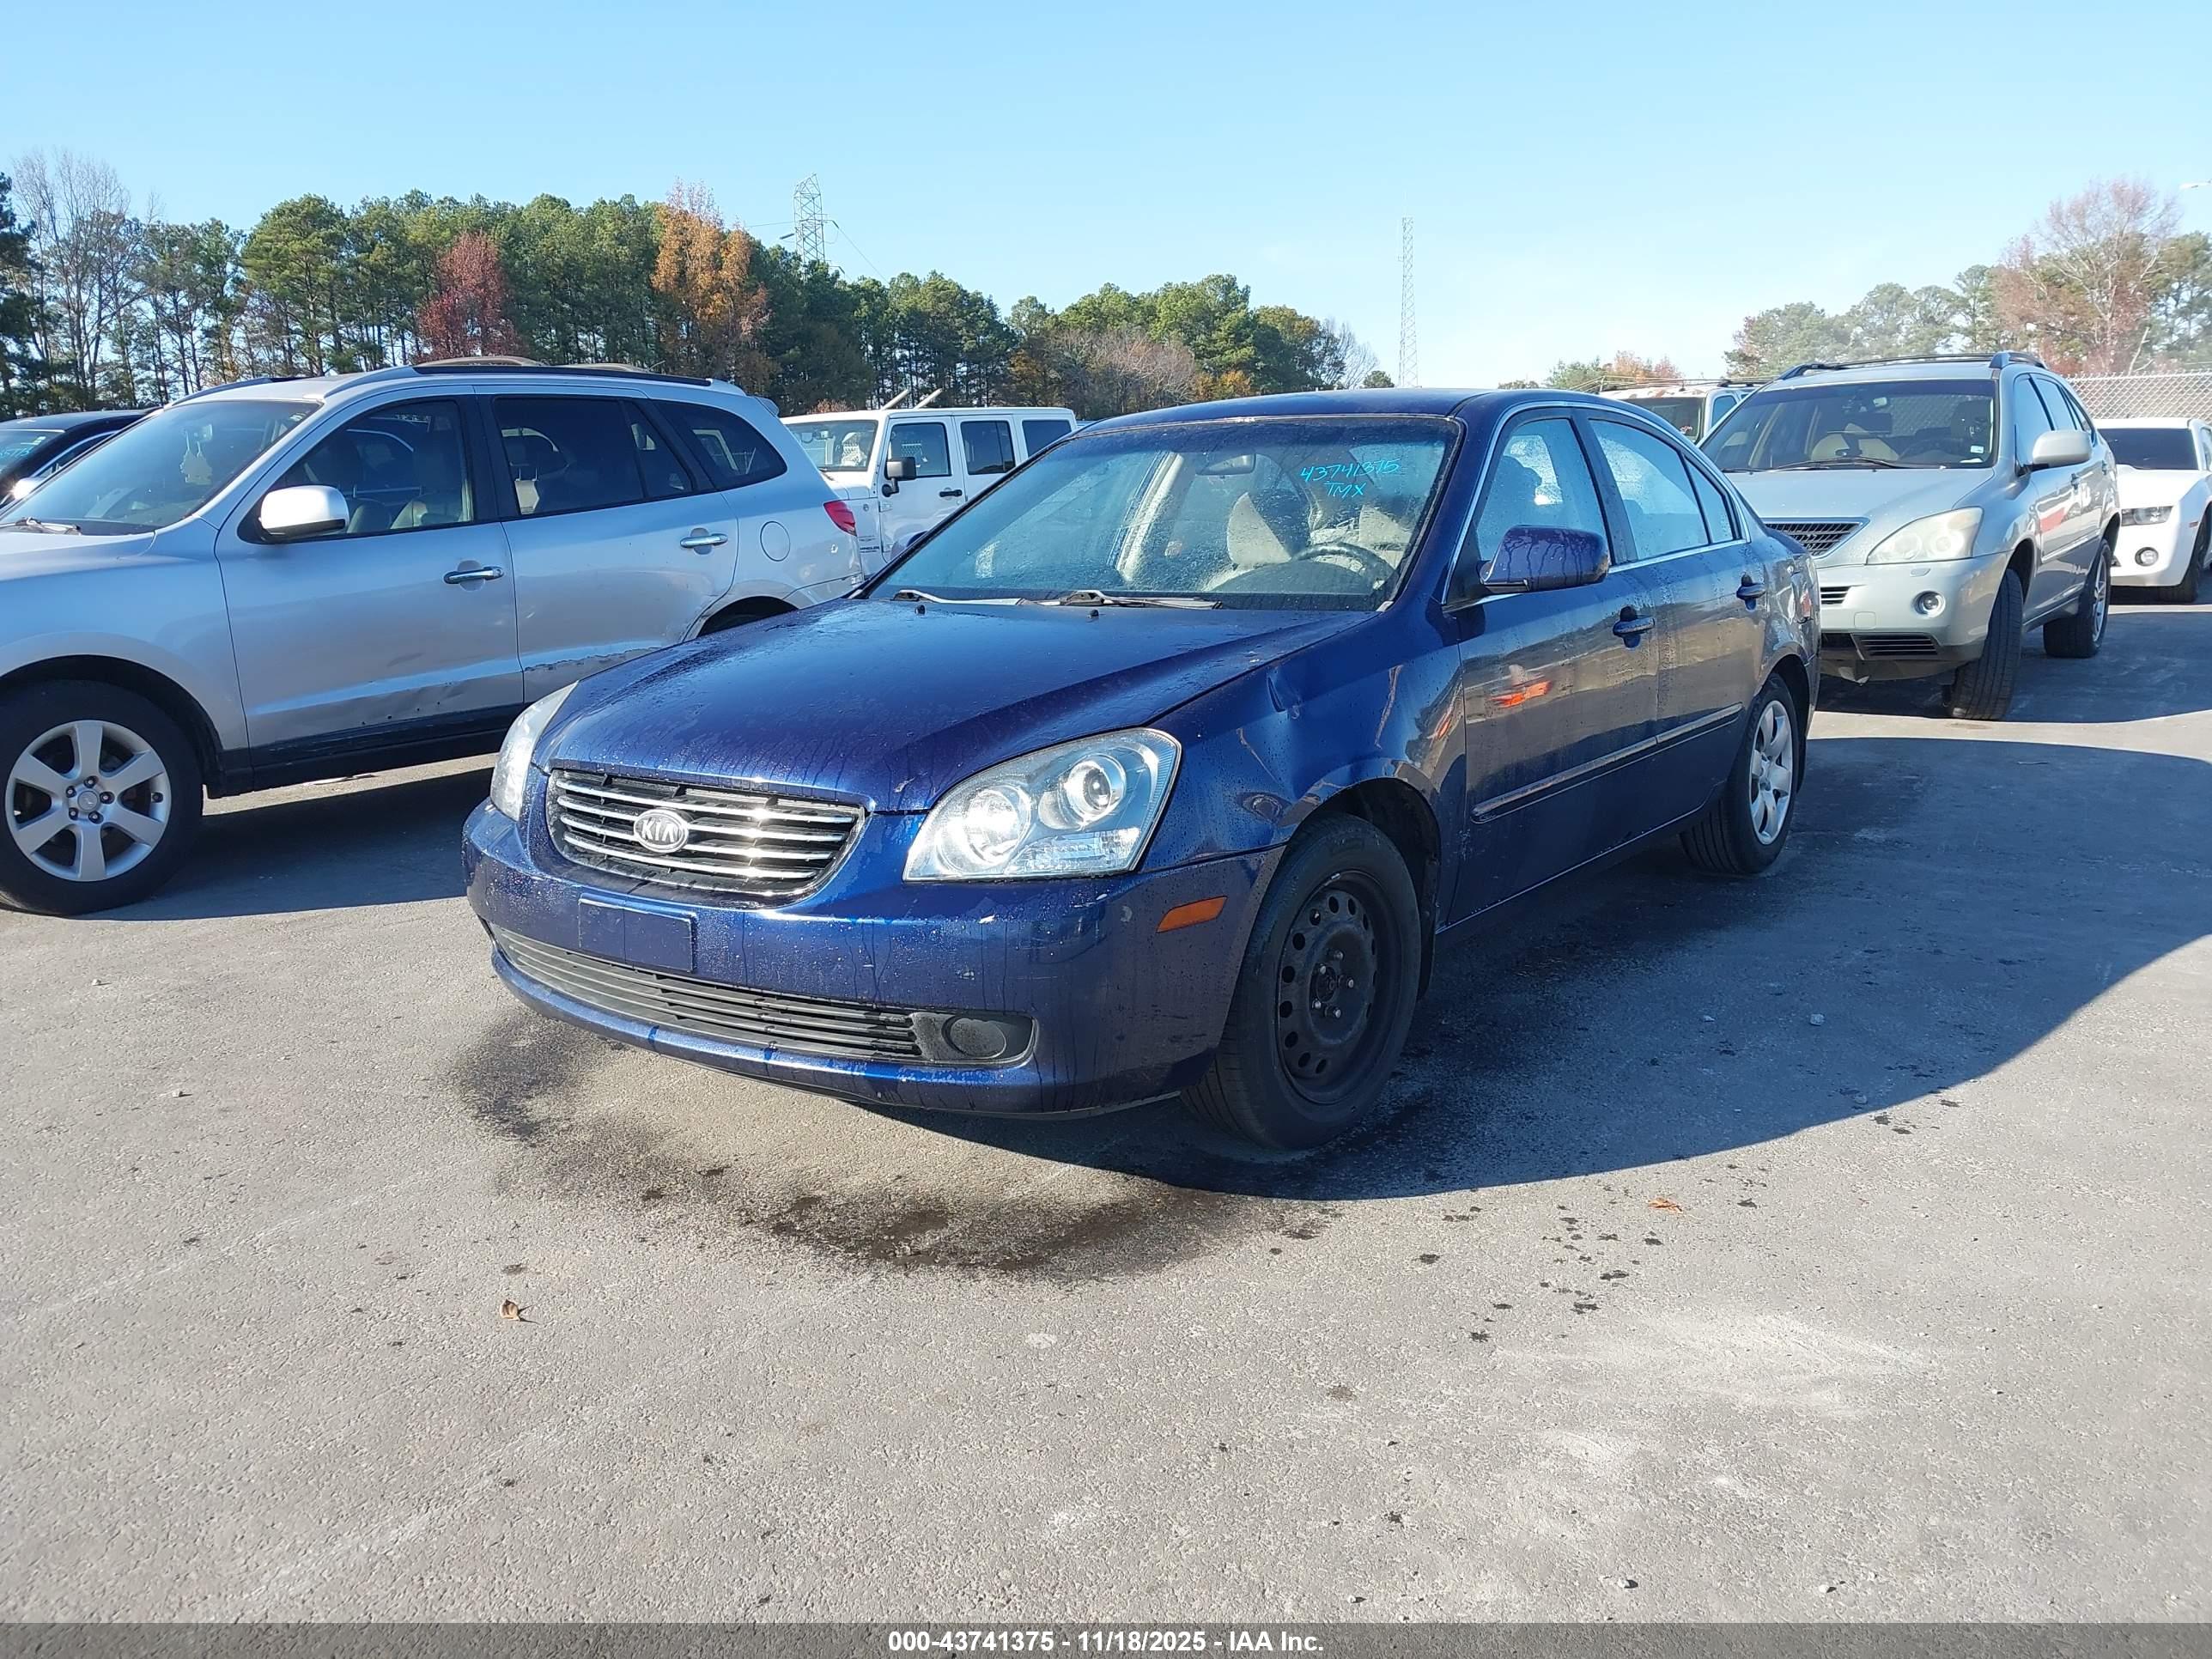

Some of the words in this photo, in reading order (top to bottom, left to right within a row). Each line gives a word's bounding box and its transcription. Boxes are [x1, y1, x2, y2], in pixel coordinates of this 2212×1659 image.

[1300, 459, 1401, 482] 43741375
[1323, 481, 1367, 498] TMX
[641, 817, 676, 842] KIA
